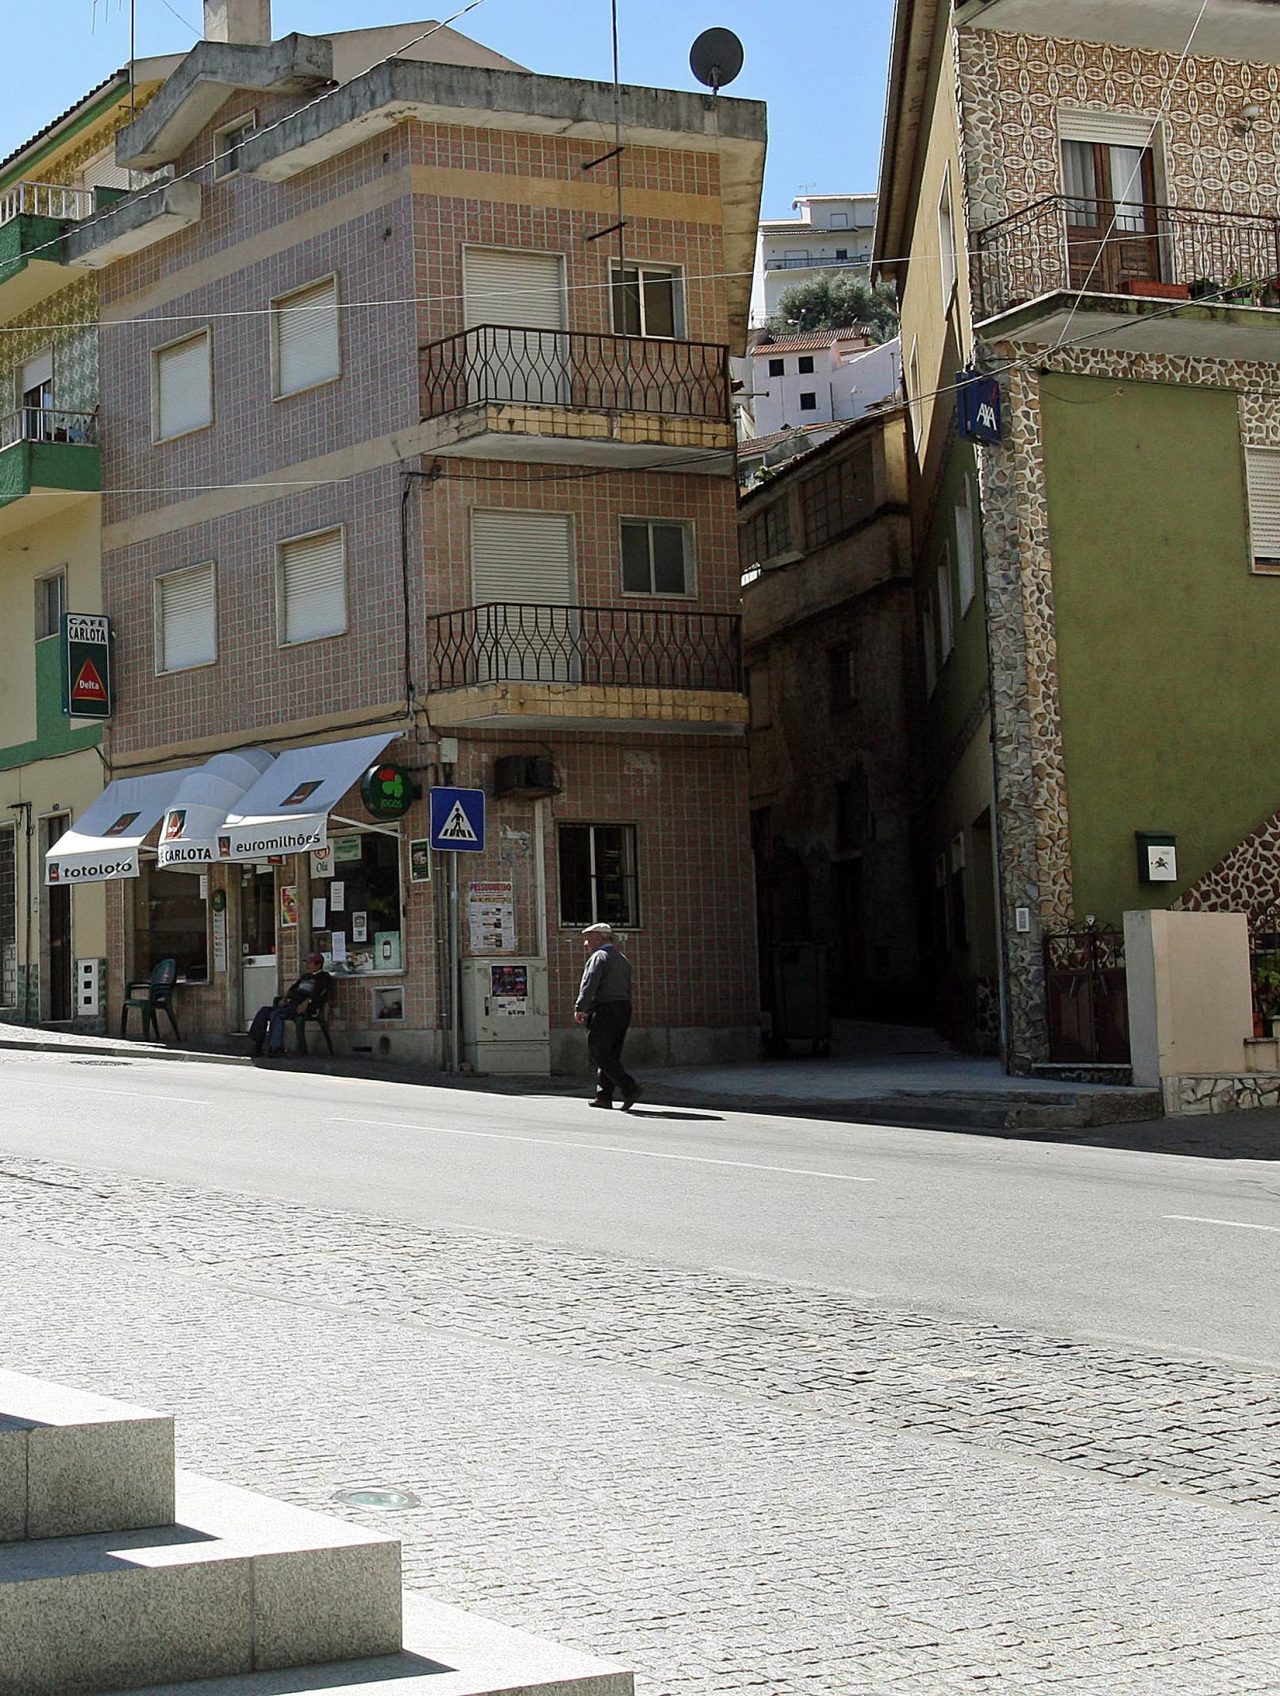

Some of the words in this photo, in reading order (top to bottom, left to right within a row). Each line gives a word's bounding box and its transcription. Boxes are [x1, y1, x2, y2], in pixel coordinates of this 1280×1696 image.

[976, 402, 997, 431] AXA
[68, 627, 107, 643] CARLOTA
[79, 680, 100, 690] Delta
[236, 833, 320, 853] euromilhões
[165, 847, 212, 862] CARLOTA
[64, 861, 132, 878] totoloto
[316, 862, 329, 873] Olá
